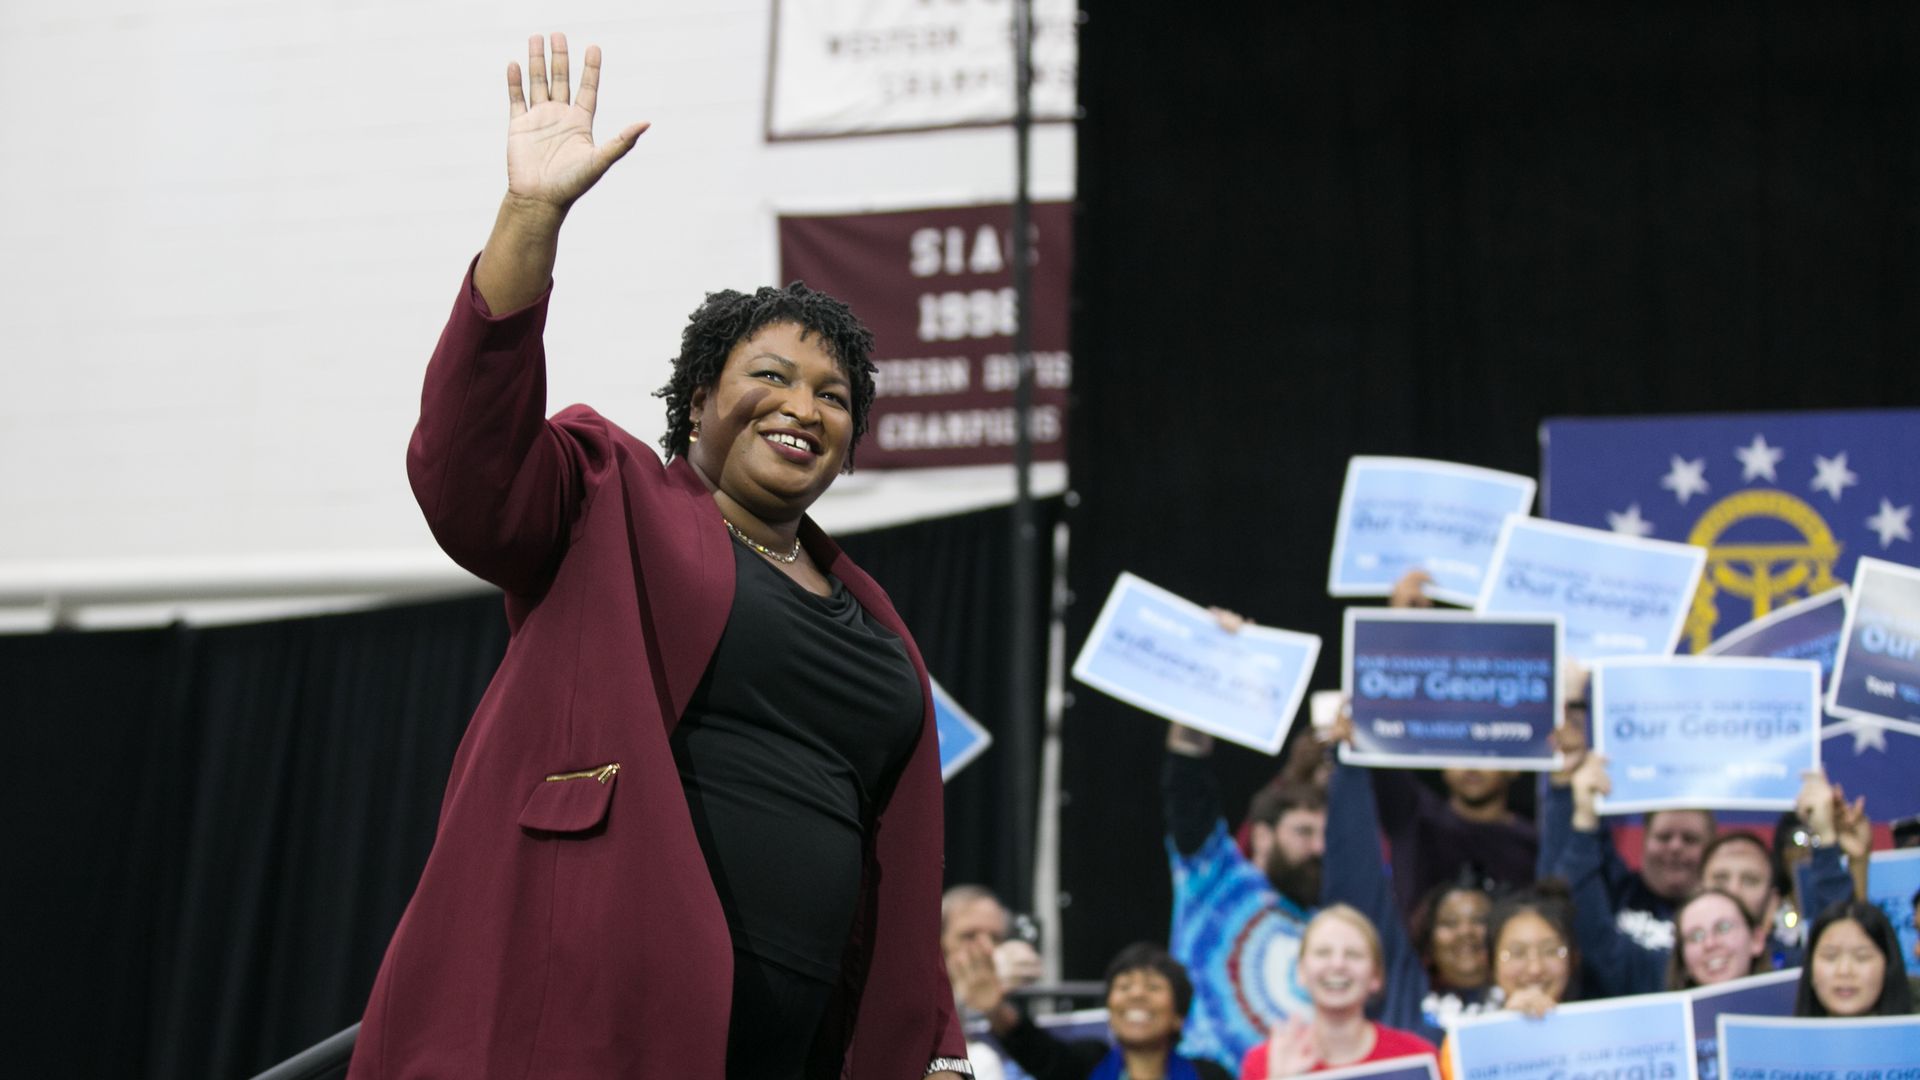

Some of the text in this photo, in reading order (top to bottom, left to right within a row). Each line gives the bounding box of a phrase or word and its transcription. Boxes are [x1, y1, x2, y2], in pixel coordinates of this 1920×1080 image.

[1359, 670, 1548, 707] Our Georgia
[1614, 712, 1801, 741] Our Georgia
